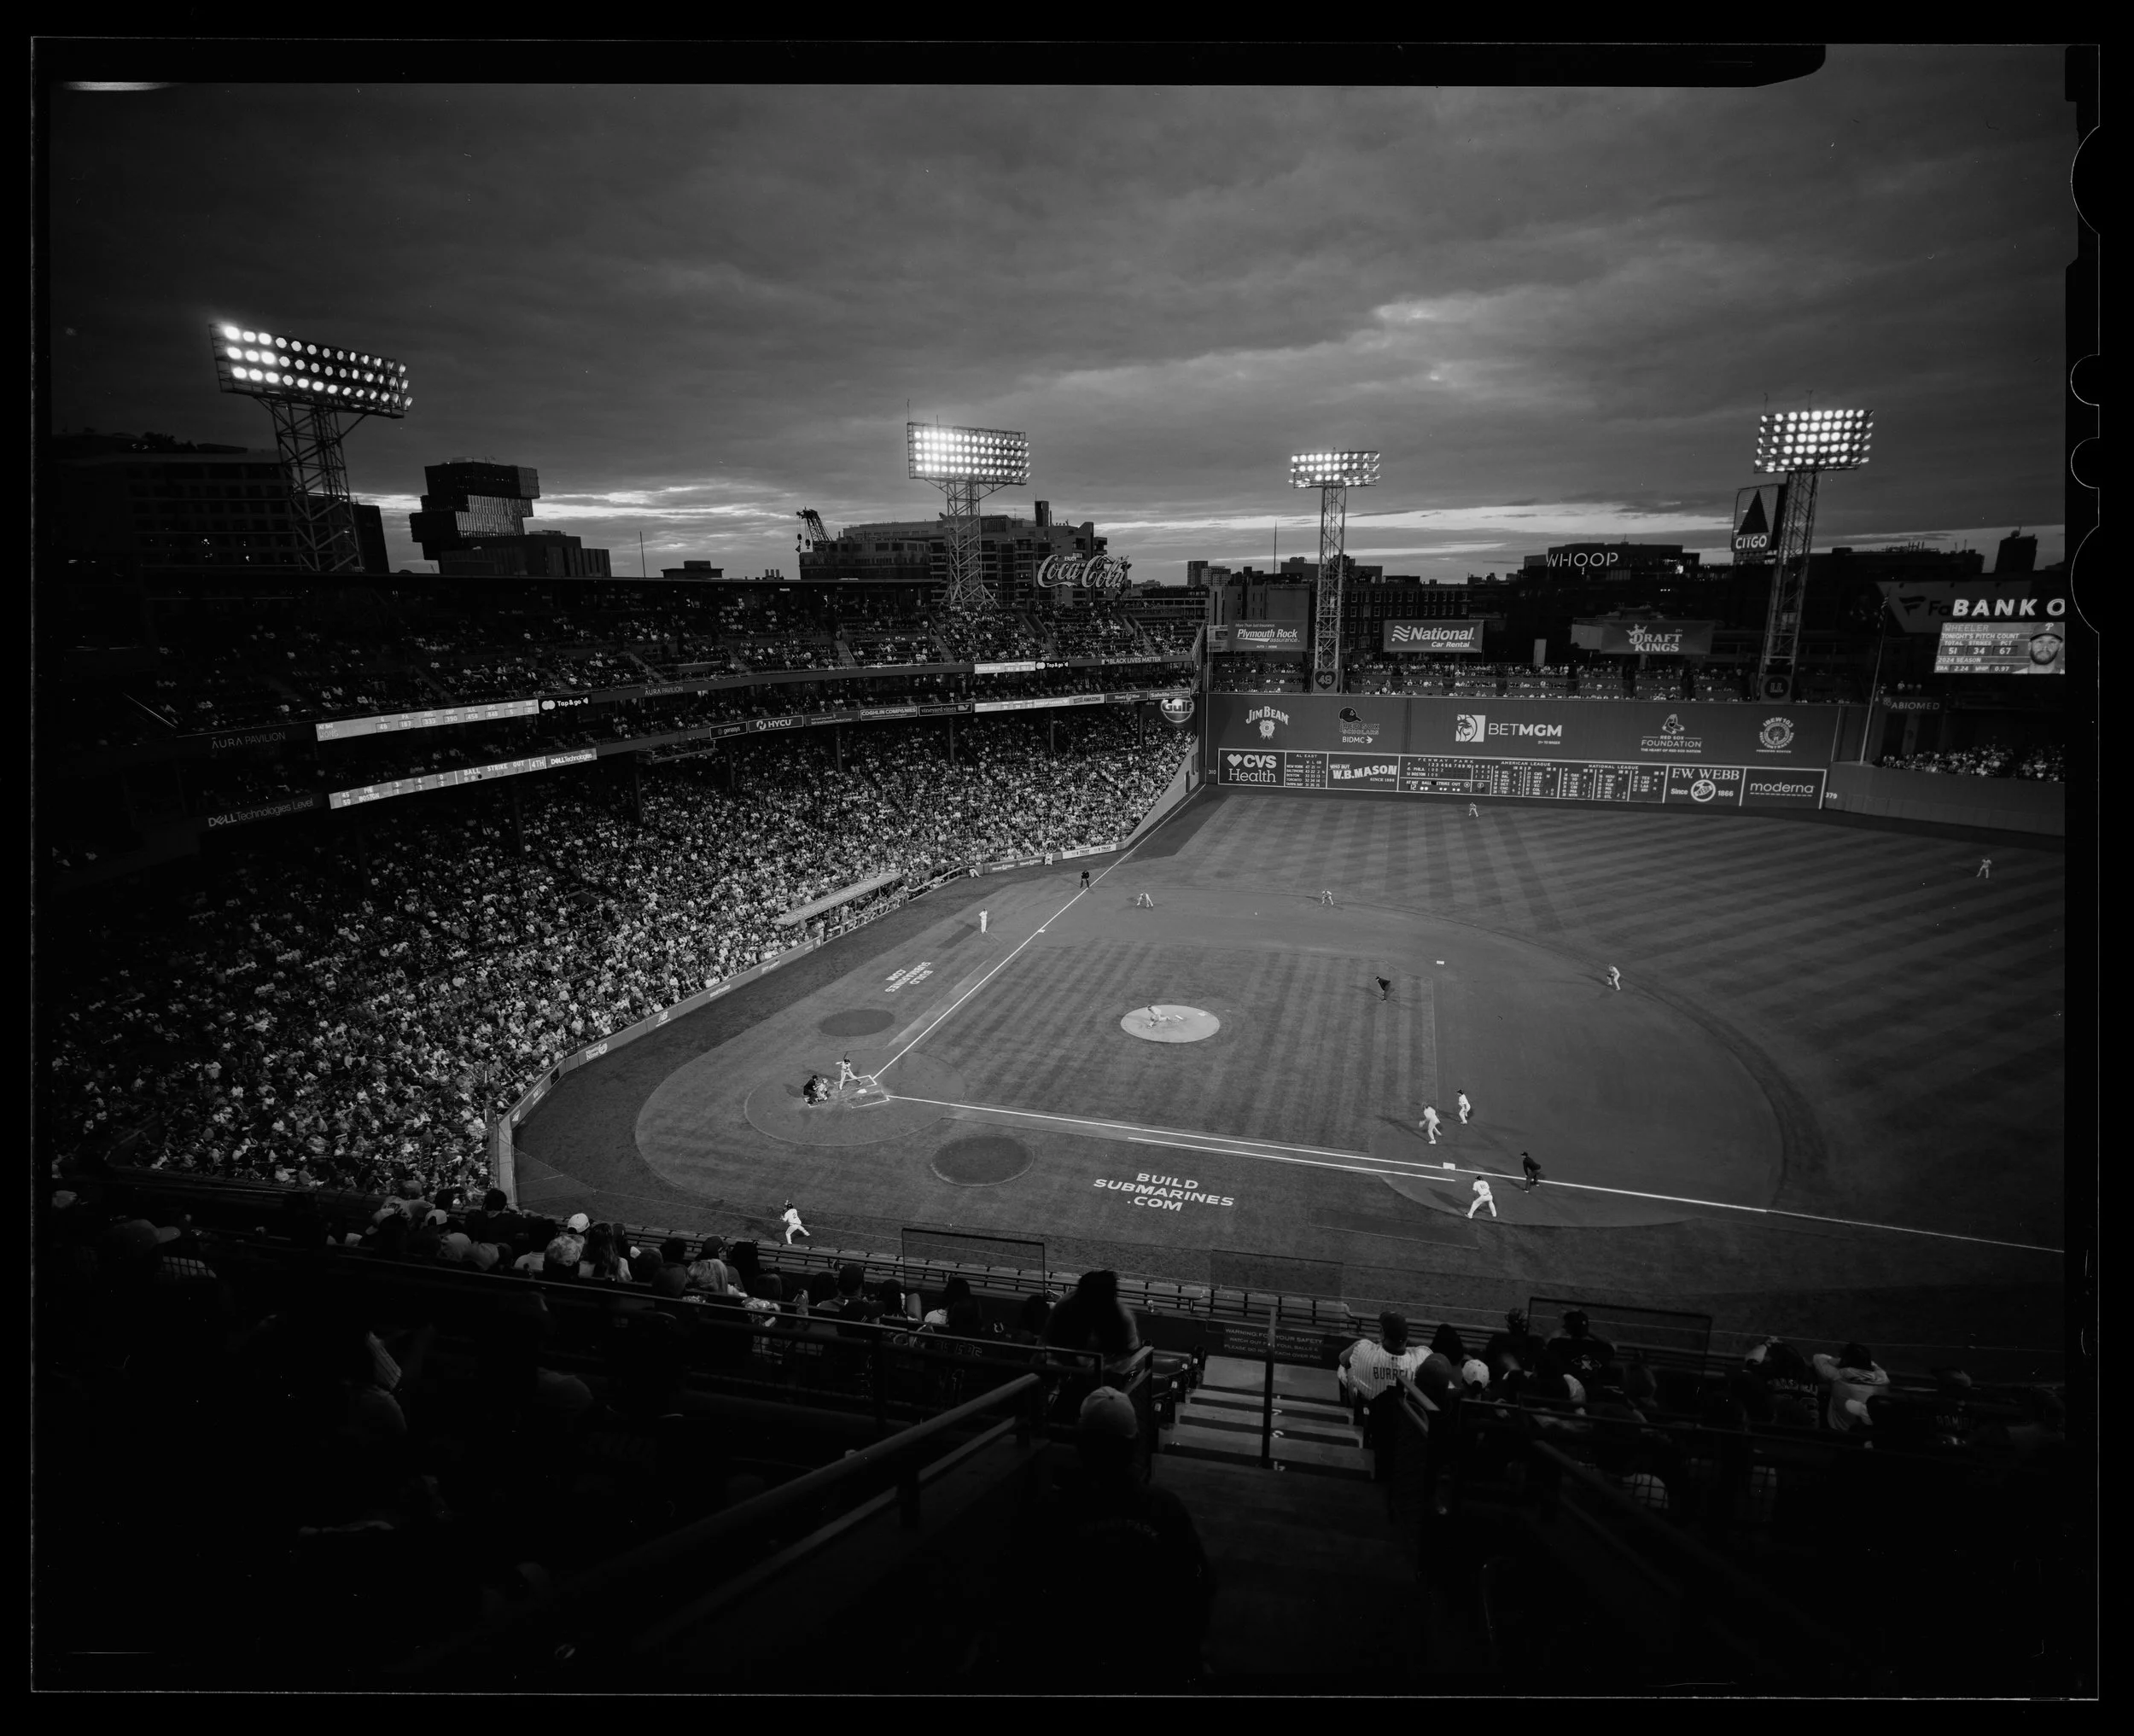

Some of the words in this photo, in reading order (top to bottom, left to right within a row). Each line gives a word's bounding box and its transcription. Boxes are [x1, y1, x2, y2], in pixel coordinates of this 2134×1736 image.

[1735, 535, 1767, 550] CITGO
[1546, 552, 1618, 567] WHOOP
[1952, 598, 2038, 615] BANK
[1237, 628, 1274, 639] Plymouth
[1276, 629, 1297, 638] Rock
[1945, 624, 1989, 632] WHEELER
[1629, 633, 1682, 644] DRAFT
[1635, 643, 1679, 652] KINGS
[1162, 699, 1192, 713] Gulf
[1891, 702, 1940, 710] ABIOMED
[1245, 708, 1263, 725] JIM
[1263, 706, 1290, 725] BEAM
[1763, 716, 1783, 727] IBEW
[768, 719, 791, 728] HYCU
[1488, 723, 1563, 737] BETMGM
[245, 731, 286, 744] PAVILION
[319, 730, 339, 738] WONG
[1641, 739, 1702, 748] FOUNDATION
[531, 760, 545, 768] 4TH
[1243, 754, 1277, 769] CVS
[464, 767, 481, 777] BALL
[487, 763, 508, 772] STRIKE
[1228, 768, 1277, 783] Health
[1671, 767, 1694, 779] F.W.
[1699, 769, 1740, 780] WEBB
[1749, 781, 1815, 794] moderna
[358, 792, 380, 802] BOSTON
[207, 813, 237, 827] DELL
[236, 803, 291, 821] Technologies
[292, 799, 313, 810] Level
[1136, 1172, 1199, 1190] BUILD
[1093, 1179, 1235, 1207] SUBMARINES
[1127, 1196, 1183, 1212] .COM
